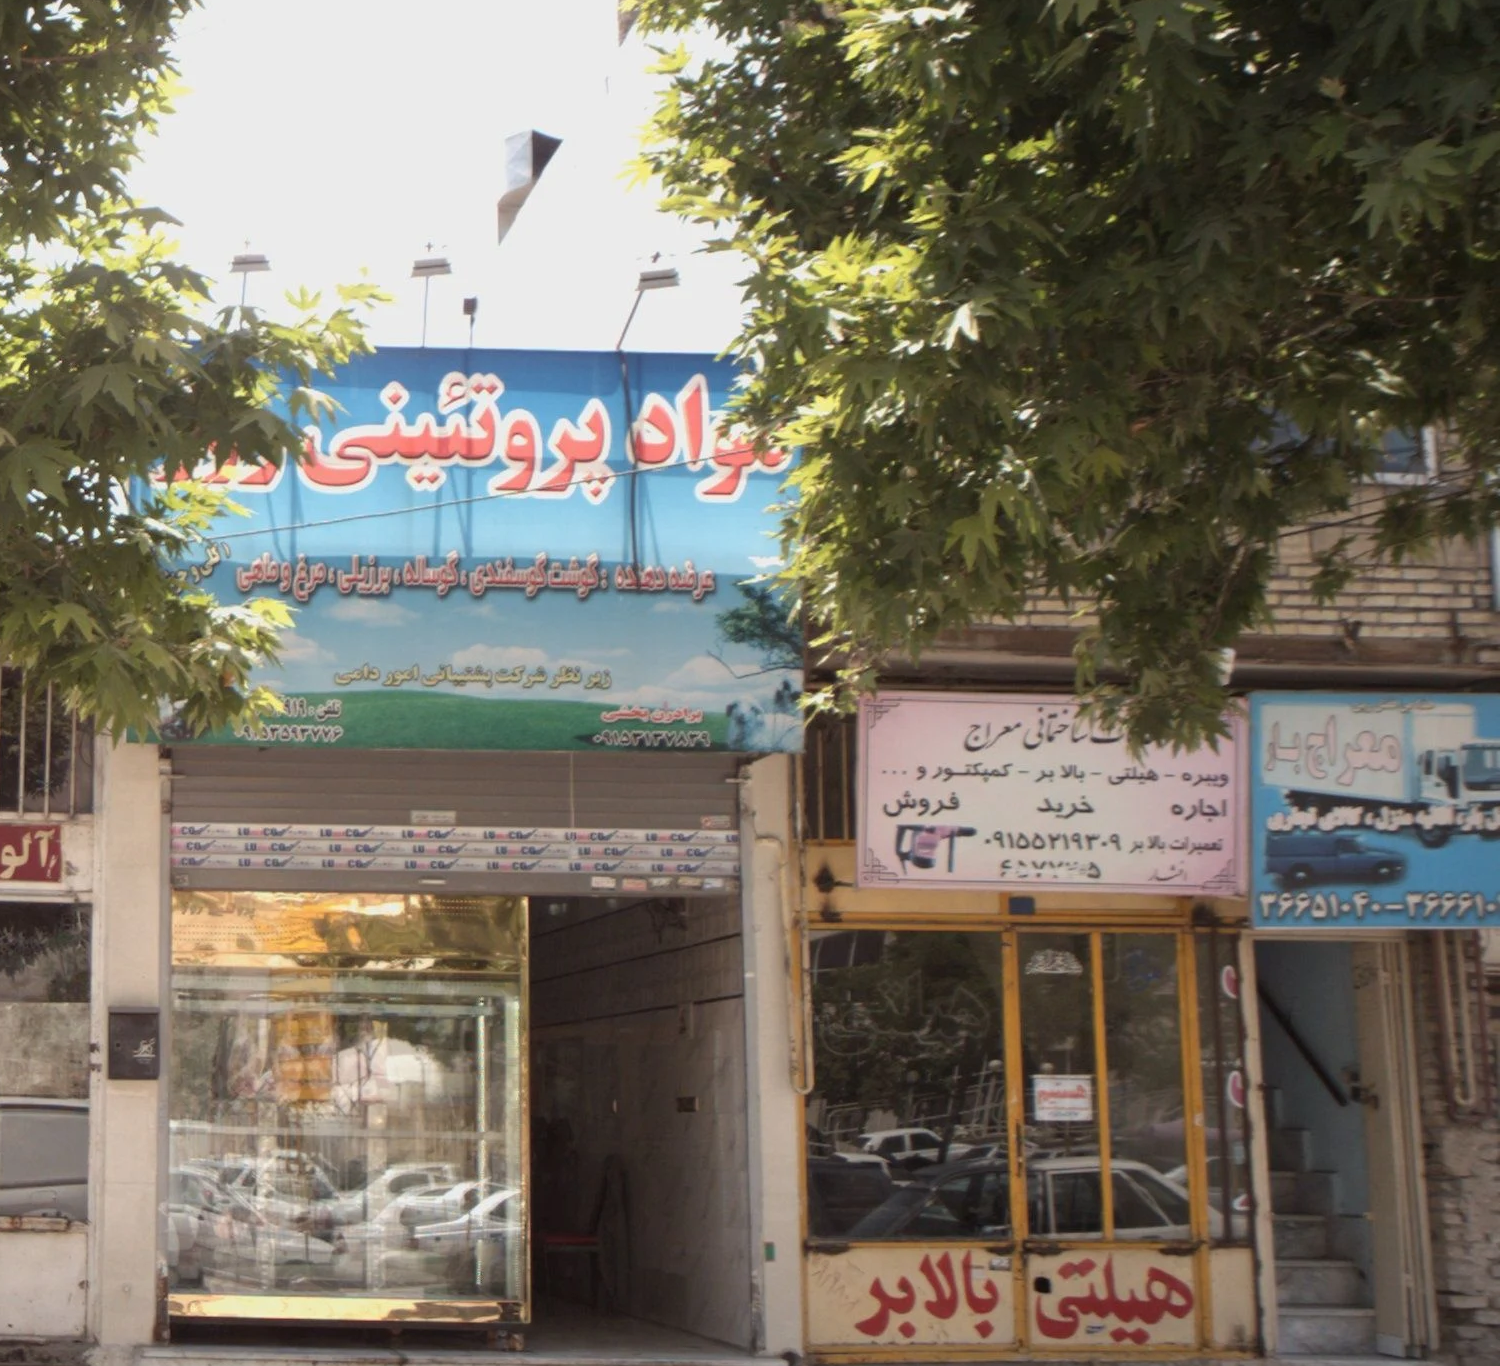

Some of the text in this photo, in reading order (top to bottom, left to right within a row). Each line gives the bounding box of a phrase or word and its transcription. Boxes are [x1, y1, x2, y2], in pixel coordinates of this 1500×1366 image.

[297, 370, 611, 503] پروتئینی
[235, 550, 280, 594] ماهی
[279, 560, 292, 593] و
[292, 552, 327, 602] مرغ
[548, 550, 600, 599] گوشت
[666, 559, 717, 601] عرضه
[334, 663, 612, 689] زیر نظر شرکت پشتیبانی امور دامی
[649, 700, 704, 724] برادران
[963, 719, 1022, 753] معراج
[1306, 713, 1401, 787] معراج
[915, 764, 928, 782] و
[1107, 766, 1159, 786] هیلتی
[1181, 769, 1230, 787] ویبره
[882, 790, 1228, 822] اجاره خرید فروش
[983, 831, 1123, 852] ۰۹۱۵۵۲۱۹۳۰۹
[1168, 836, 1225, 855] تعمیرات
[1034, 1252, 1195, 1346] هیلتی
